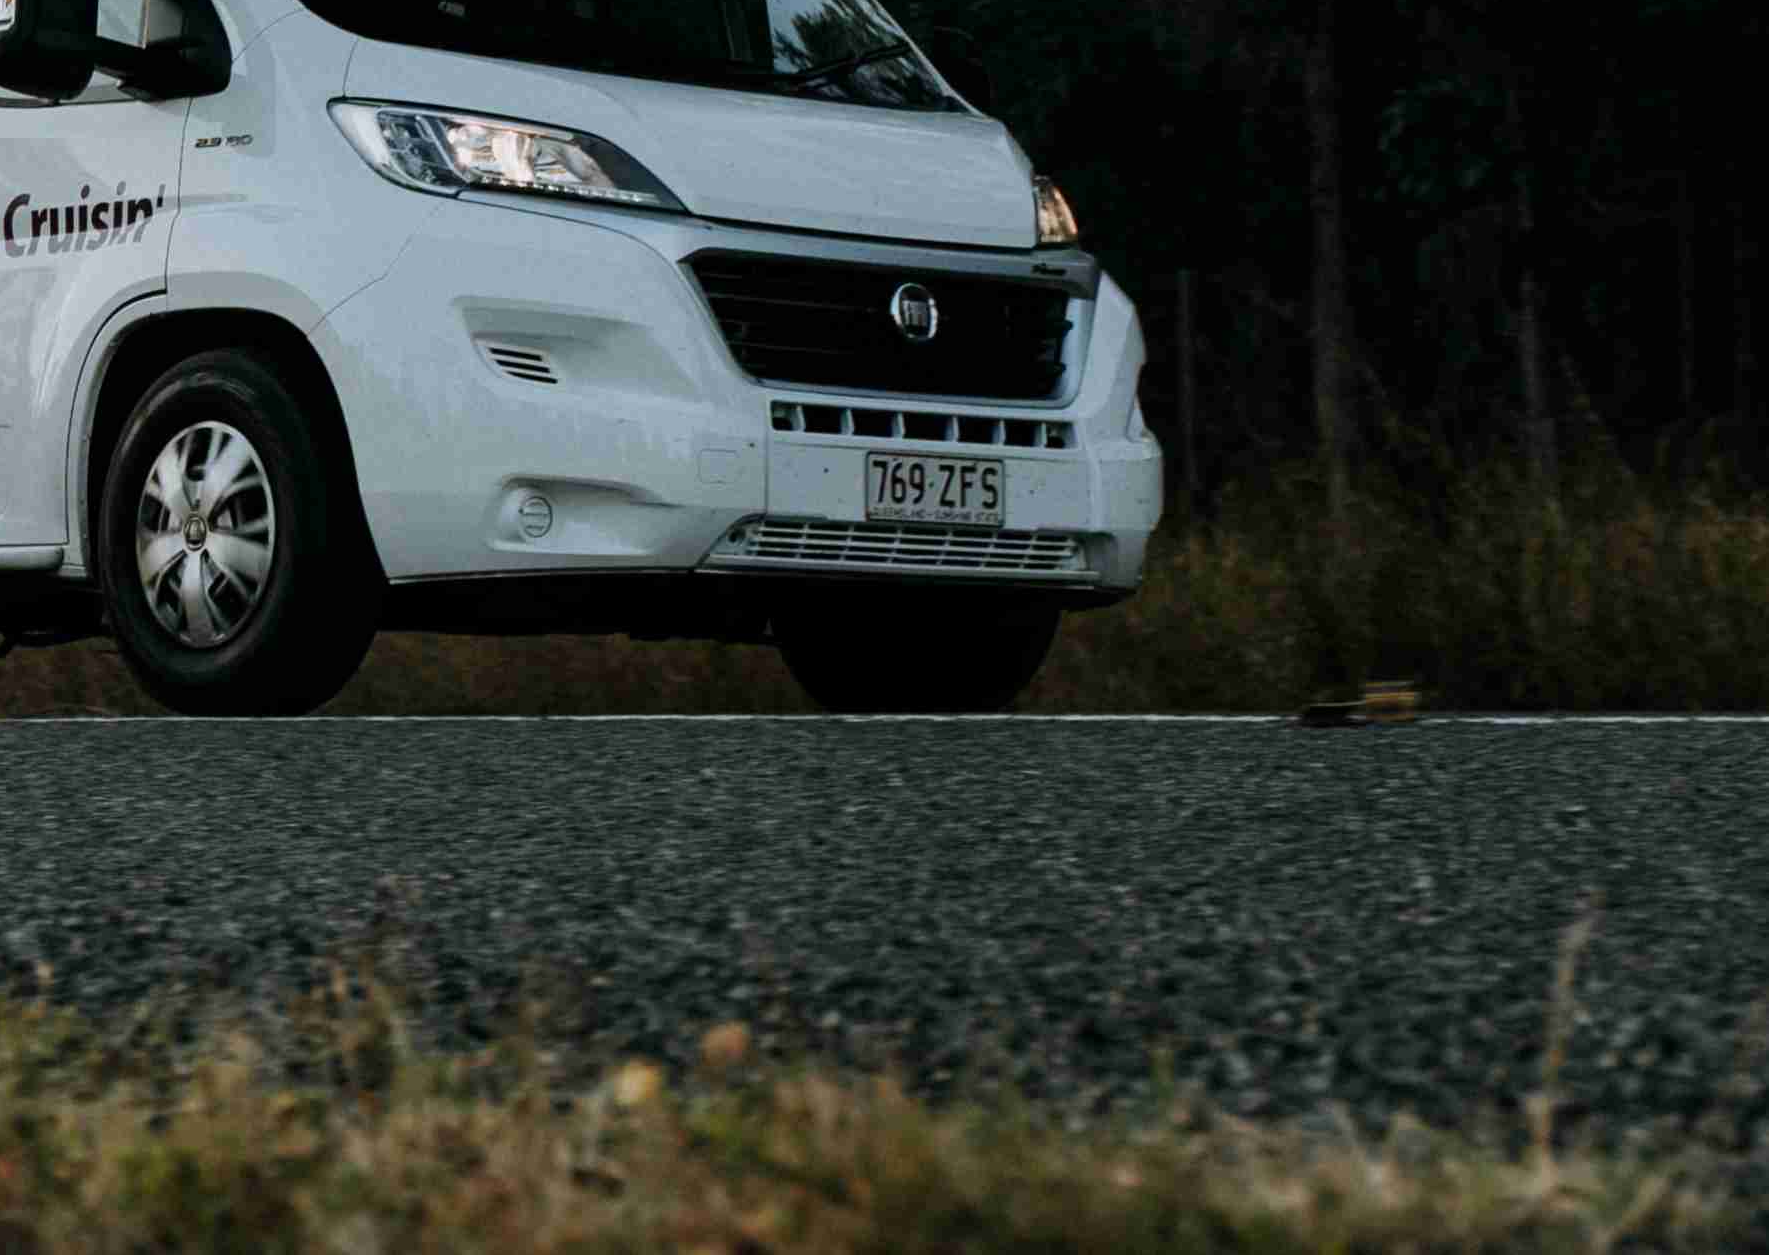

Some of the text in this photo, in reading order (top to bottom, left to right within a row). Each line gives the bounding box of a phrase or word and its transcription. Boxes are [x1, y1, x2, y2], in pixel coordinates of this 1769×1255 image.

[4, 180, 166, 258] Cruisin'
[872, 459, 999, 510] 769 ZFS
